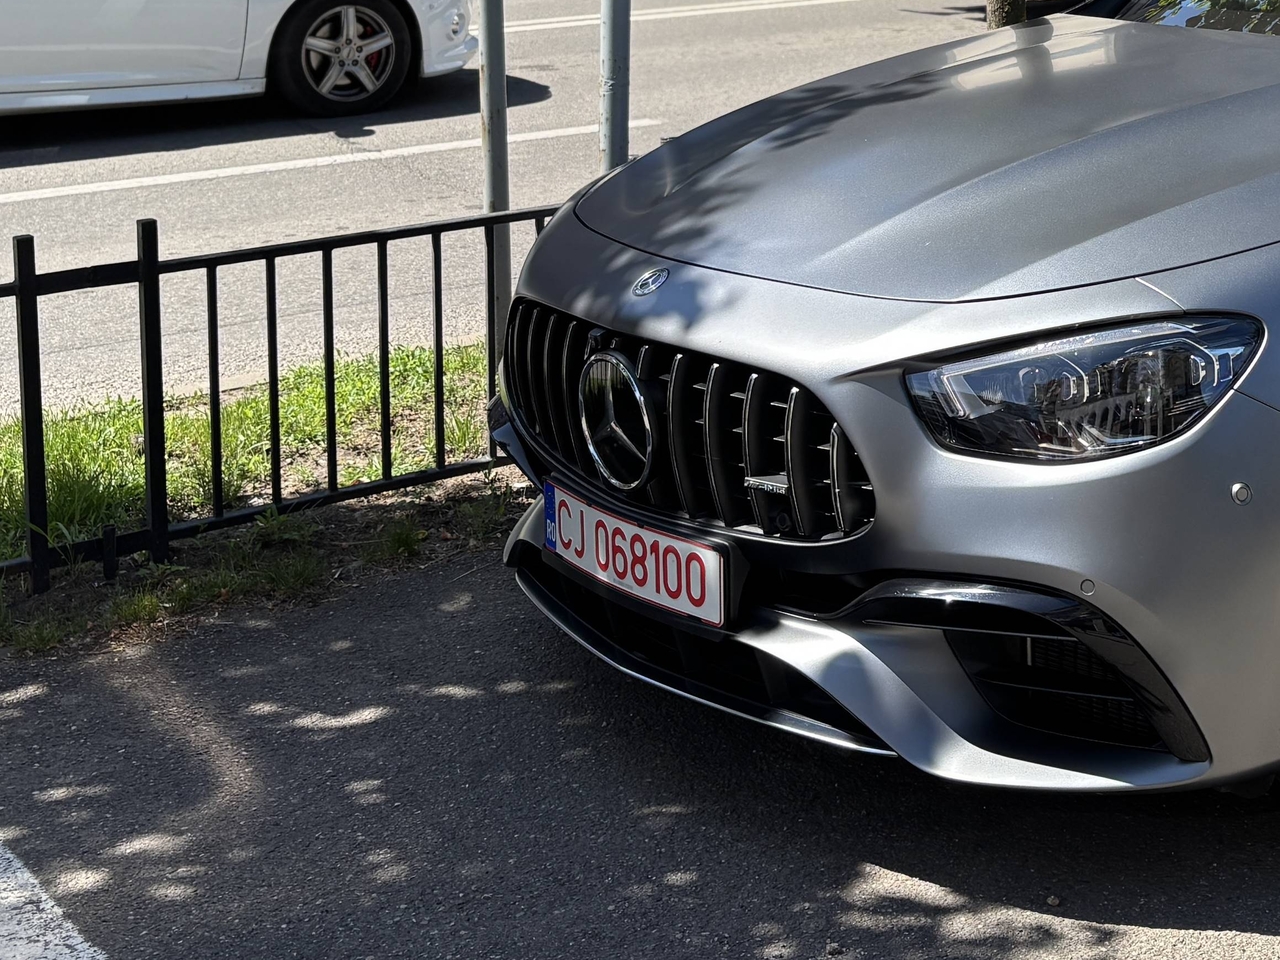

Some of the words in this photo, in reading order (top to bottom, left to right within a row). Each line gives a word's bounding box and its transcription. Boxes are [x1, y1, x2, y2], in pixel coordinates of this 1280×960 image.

[546, 519, 556, 542] RO
[558, 499, 585, 559] CJ
[595, 519, 706, 607] 068100
